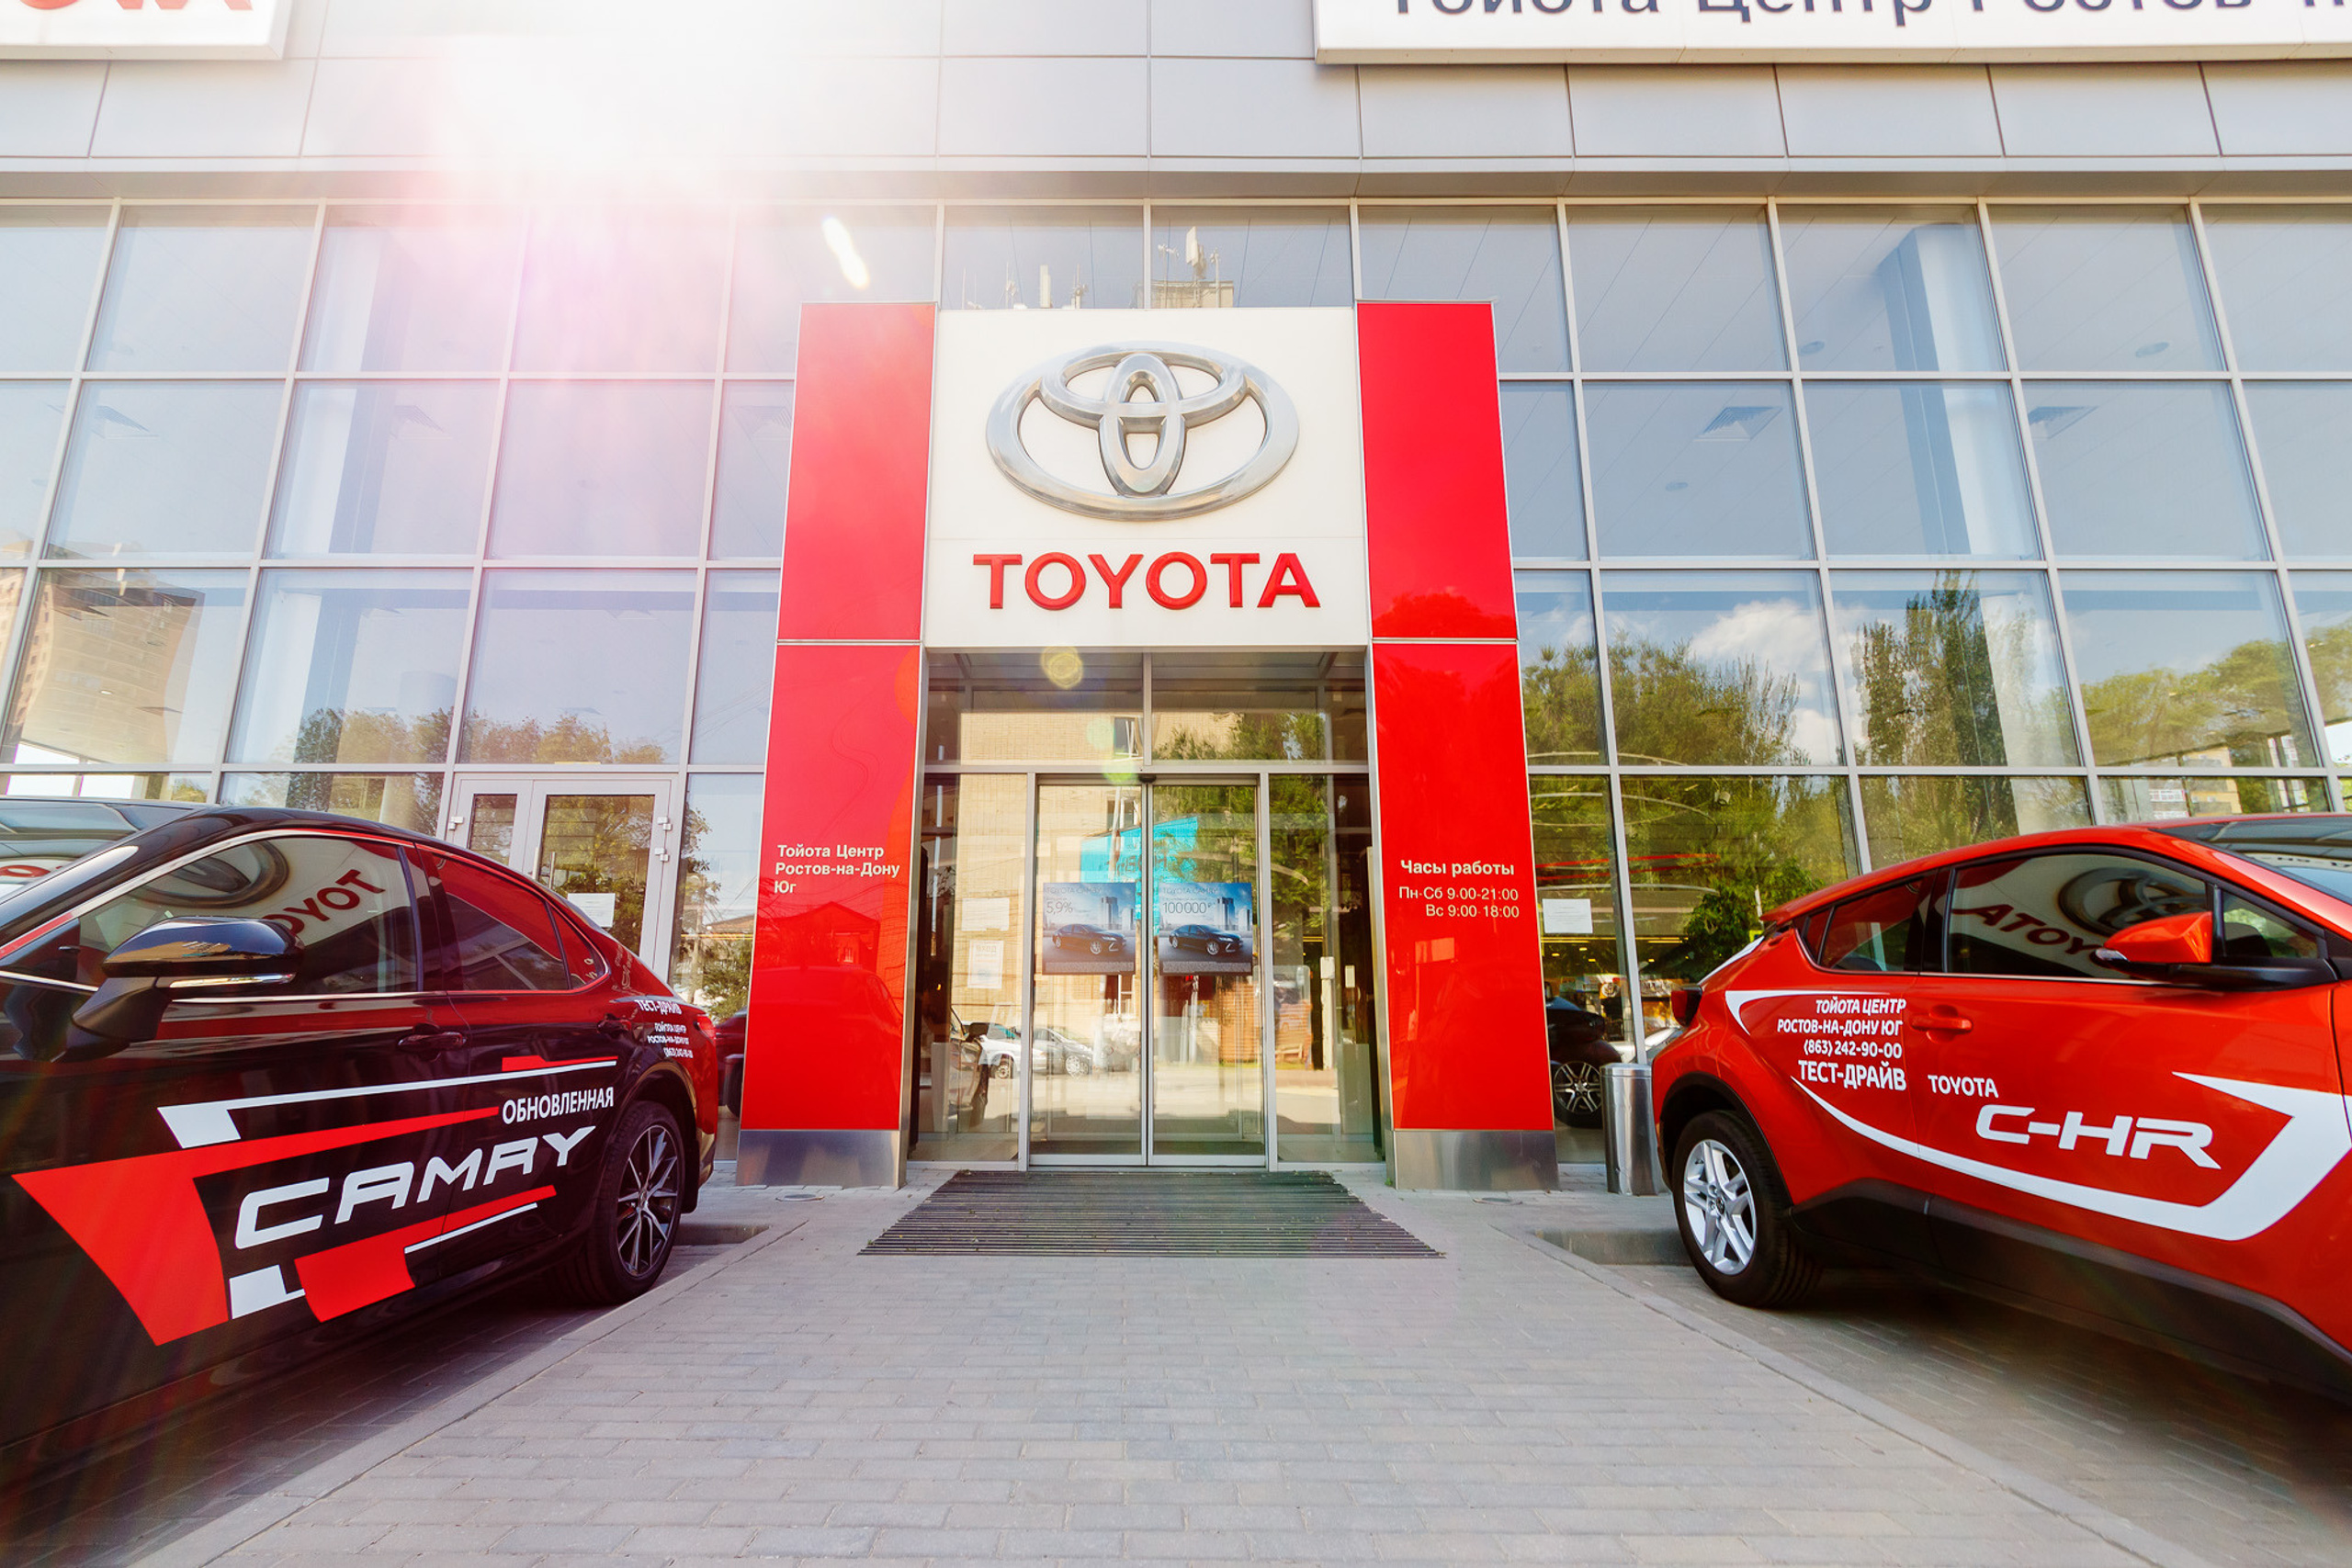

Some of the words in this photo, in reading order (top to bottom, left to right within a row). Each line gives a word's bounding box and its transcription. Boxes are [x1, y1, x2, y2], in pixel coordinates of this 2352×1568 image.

[973, 551, 1321, 610] TOYOTA
[777, 844, 831, 858] Тойота
[836, 844, 884, 860] Центр
[775, 863, 900, 878] Ростов-на-Дону
[1400, 860, 1446, 874] Часы
[1452, 860, 1515, 878] работы
[774, 880, 797, 894] Юг
[1398, 886, 1443, 899] Пн-Сб
[1046, 900, 1073, 915] 5,9%
[1426, 904, 1444, 917] Вс
[1815, 996, 1860, 1014] ТОЙОТА
[1862, 998, 1906, 1016] ЦЕНТР
[1777, 1019, 1879, 1037] РОСТОВ-НА-ДОНУ
[1881, 1020, 1903, 1036] ЮГ
[1804, 1039, 1833, 1056] (863)
[1835, 1041, 1902, 1058] 242-90-00
[1798, 1060, 1906, 1091] ТЕСТ-ДРАЙВ
[1928, 1075, 1998, 1098] TOYOTA
[503, 1087, 614, 1124] ОБНОВЛЕННАЯ
[1976, 1104, 2222, 1169] C-HR
[235, 1125, 596, 1249] CAMRY
